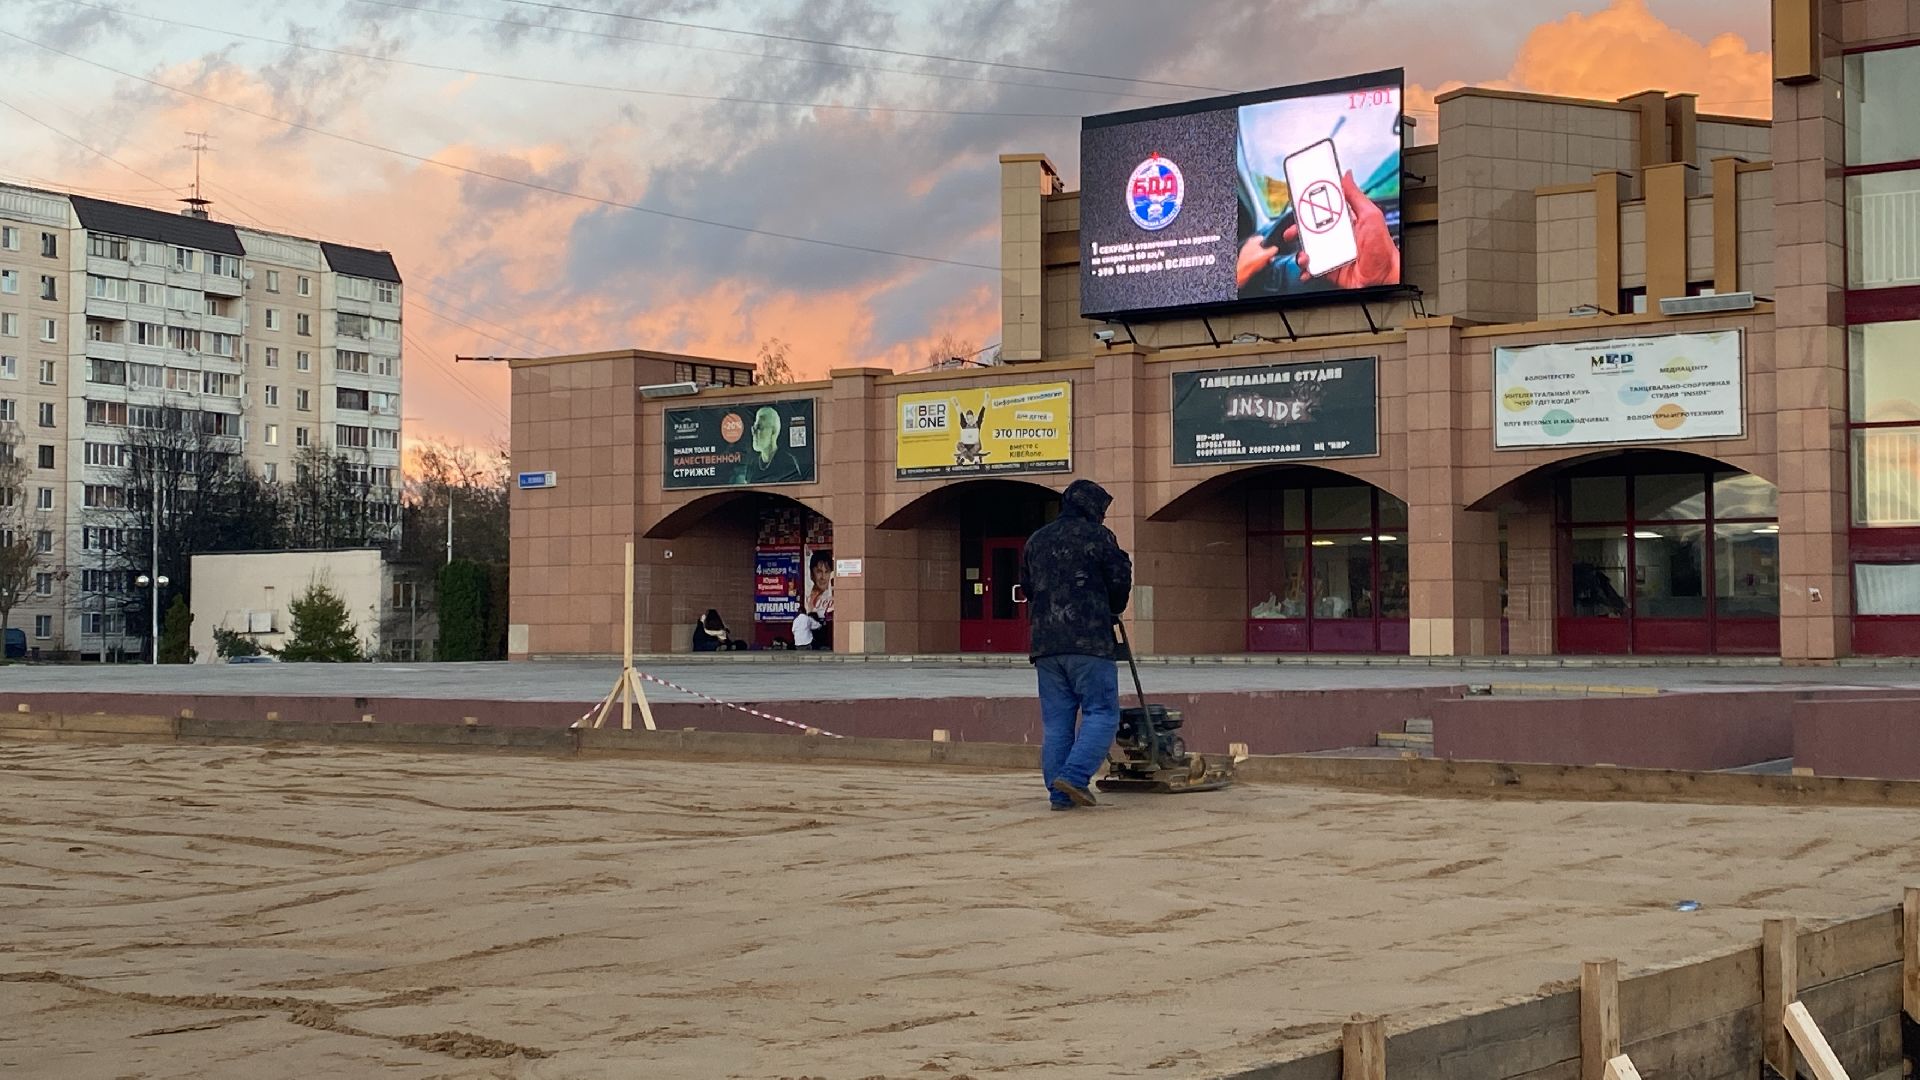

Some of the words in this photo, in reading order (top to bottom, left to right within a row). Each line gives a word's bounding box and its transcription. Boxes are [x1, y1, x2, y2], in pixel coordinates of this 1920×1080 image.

[1349, 87, 1393, 110] 17:01
[1133, 176, 1173, 196] БДД
[1091, 242, 1098, 255] 1
[1099, 243, 1134, 254] СЕКУНДА
[1102, 254, 1135, 264] скорости
[1098, 267, 1114, 277] это
[1116, 264, 1127, 274] 16
[1128, 262, 1163, 274] метров
[1165, 254, 1215, 270] ВСЛЕПУЮ
[1659, 365, 1708, 374] МЕДИАЦЕНТР
[1200, 372, 1290, 388] ТАНЦЕВАЛЬНАЯ
[1294, 368, 1342, 382] СТУДИЯ
[1629, 380, 1731, 392] ТАНЦЕВАЛЬНО-СПОРТИВНАЯ
[993, 398, 1025, 407] Цифровые
[1027, 391, 1063, 401] технологии
[1227, 397, 1305, 421] INSIDE
[918, 416, 946, 428] ONE
[995, 428, 1013, 438] ЭТО
[1015, 428, 1057, 438] ПРОСТО!
[674, 447, 693, 455] ЗНАЕМ
[694, 446, 710, 454] ТОЛК
[1010, 443, 1033, 451] вместе
[1196, 440, 1241, 449] АКРОБАТИКА
[1196, 446, 1246, 456] СОВРЕМЕННАЯ
[1249, 444, 1300, 454] ХОРЕОГРАФИЯ
[673, 451, 741, 466] КАЧЕСТВЕННОЙ
[673, 466, 716, 478] СТРИЖКЕ
[756, 563, 762, 575] 4
[762, 567, 787, 575] НОЯБРЯ
